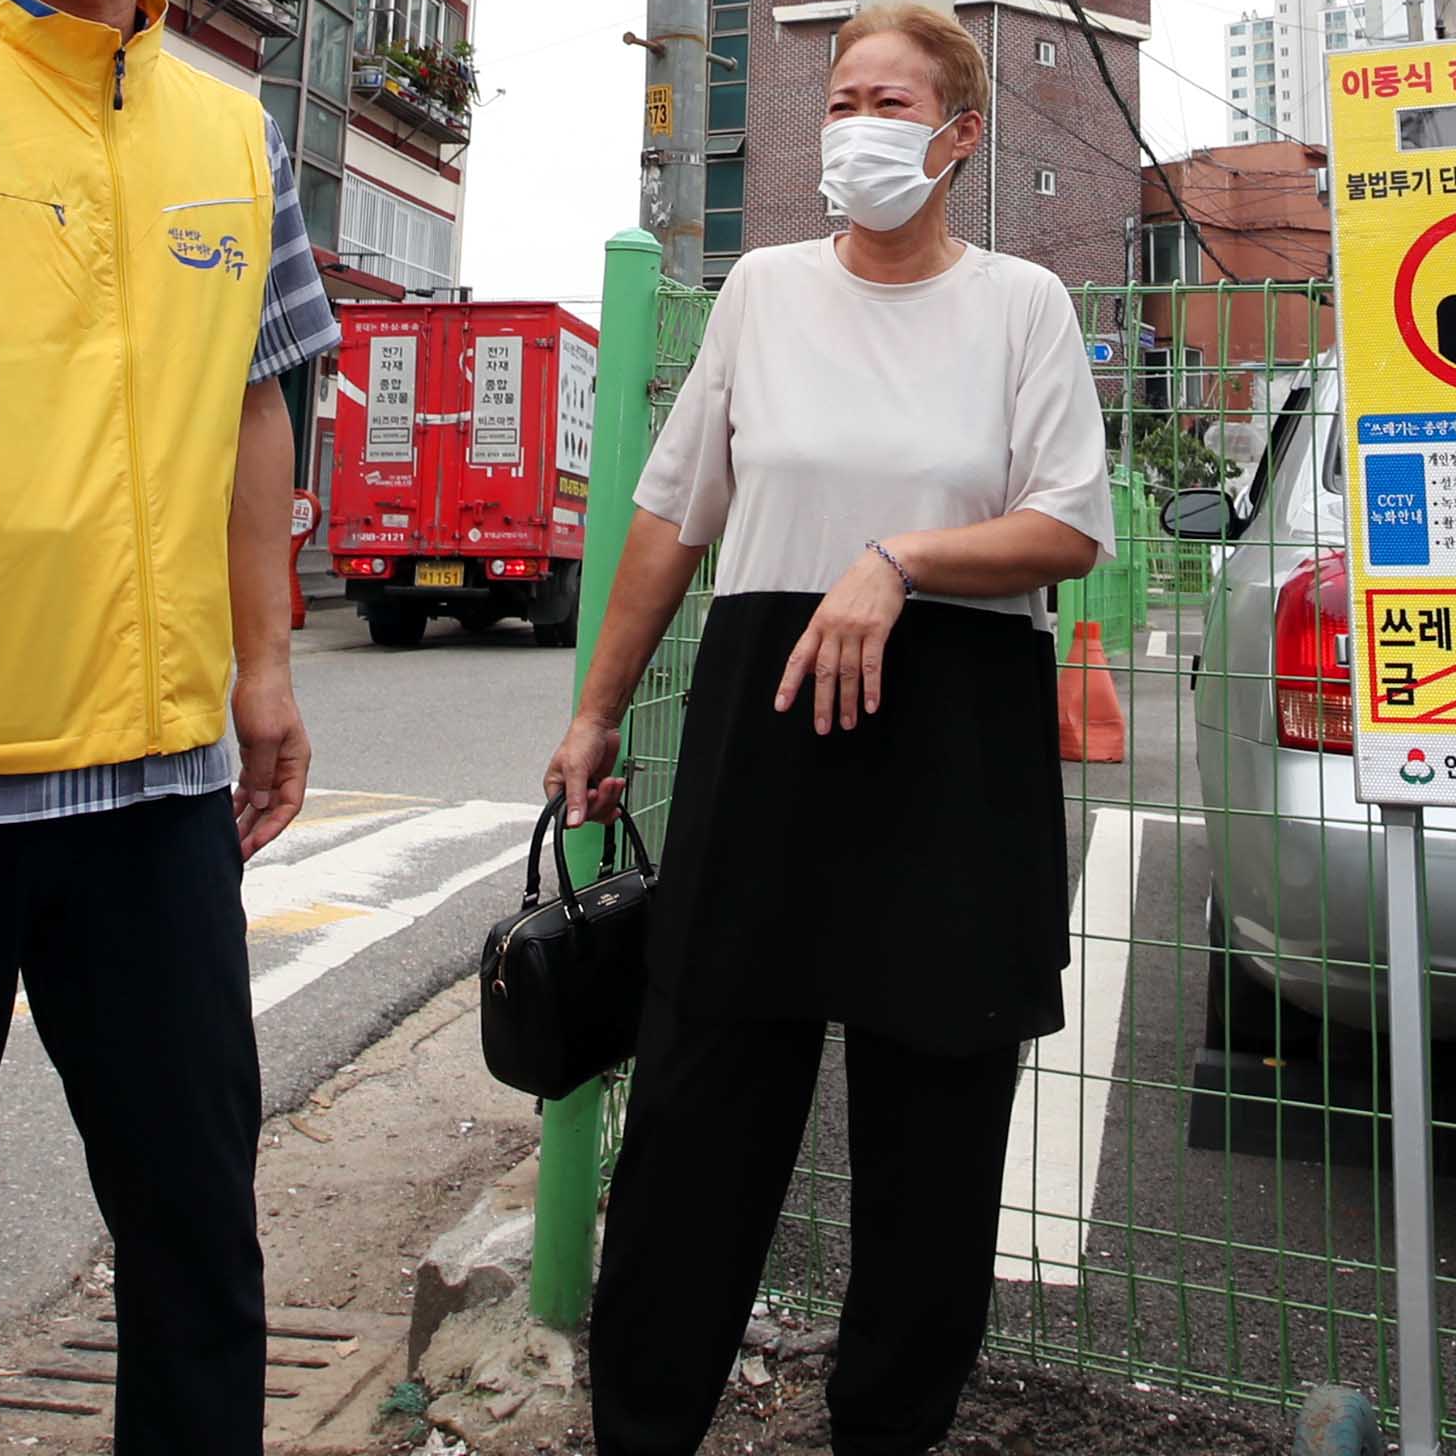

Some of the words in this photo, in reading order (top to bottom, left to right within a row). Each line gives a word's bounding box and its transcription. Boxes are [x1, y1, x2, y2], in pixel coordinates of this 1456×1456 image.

[1342, 62, 1433, 99] 이동식
[1346, 170, 1432, 200] 불법투기
[382, 346, 403, 358] 전기
[488, 346, 509, 358] 전기
[376, 393, 408, 404] 쇼핑몰
[482, 393, 514, 404] 쇼핑몰
[1377, 494, 1414, 507] CCTV
[1370, 509, 1423, 525] 녹화안내
[352, 532, 404, 542] 1588-2121
